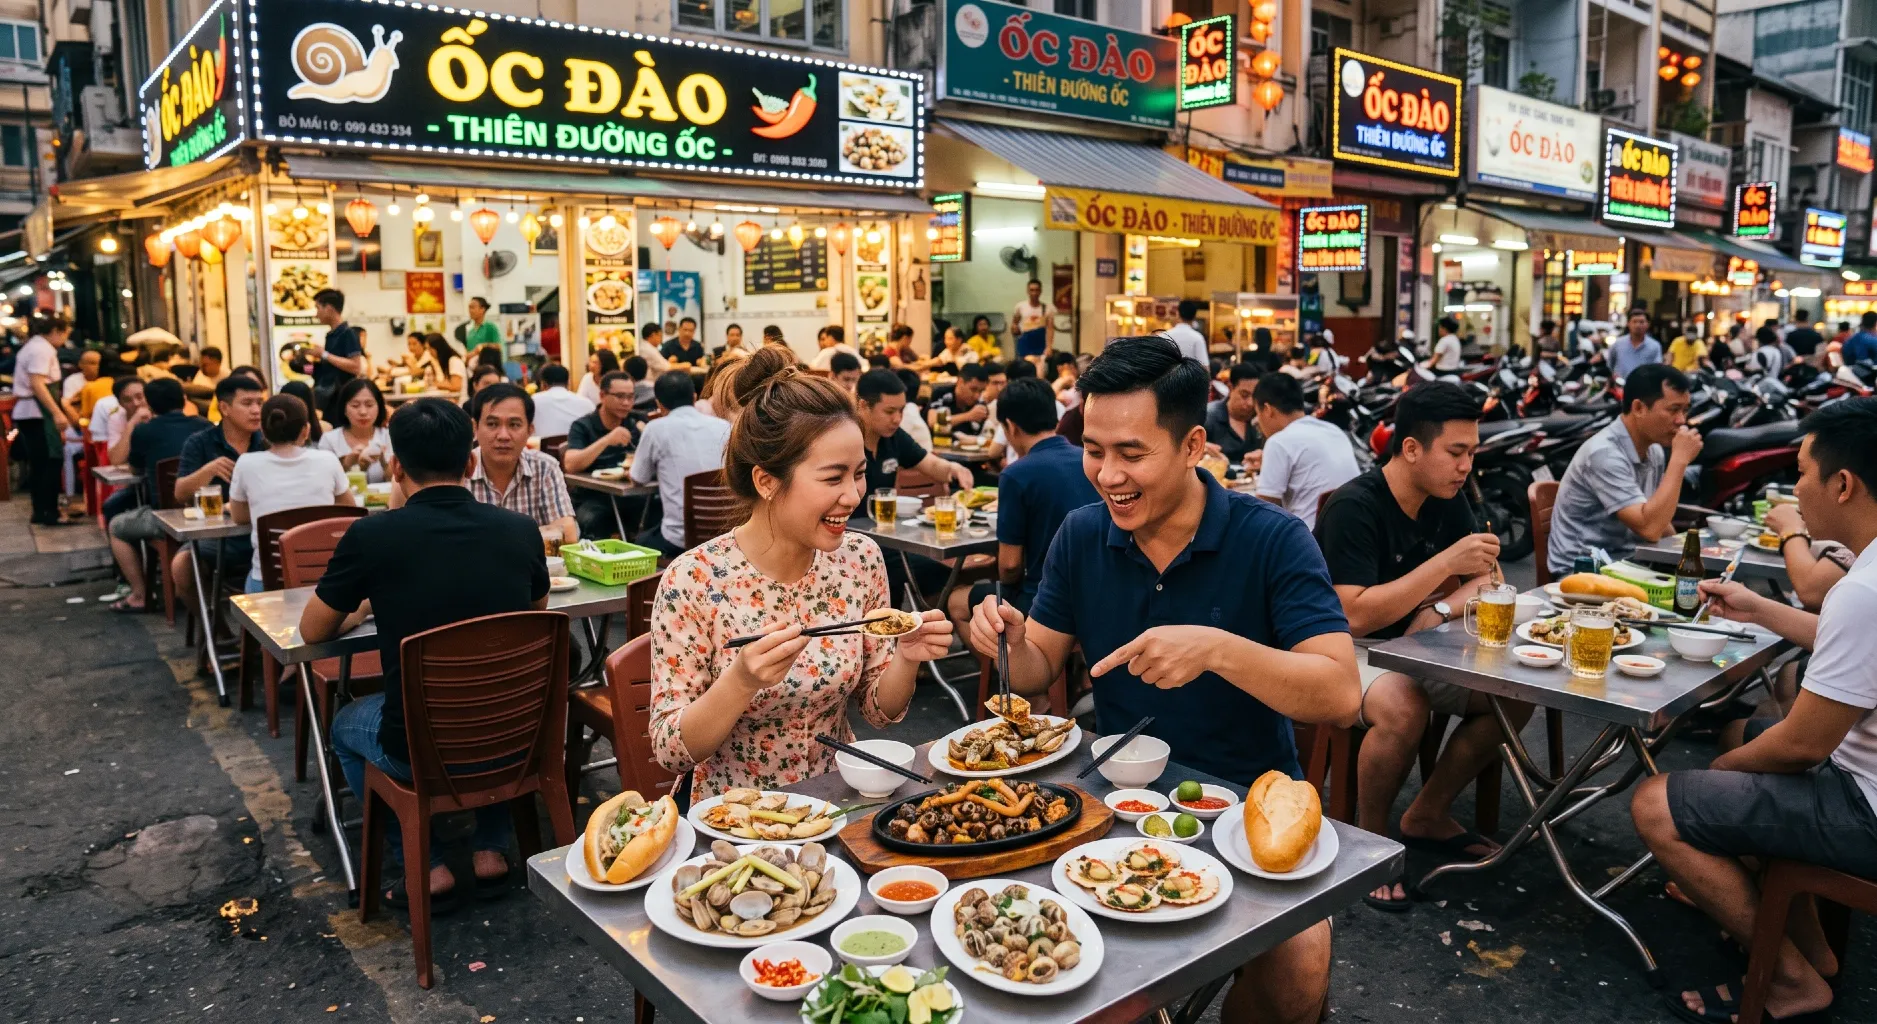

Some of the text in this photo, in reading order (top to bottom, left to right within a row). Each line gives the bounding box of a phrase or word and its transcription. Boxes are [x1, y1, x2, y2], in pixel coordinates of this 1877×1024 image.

[999, 12, 1155, 83] ỐC ĐÀO
[1188, 23, 1225, 58] ỐC
[427, 19, 727, 125] ỐC ĐÀO
[1012, 70, 1057, 95] THIÊN
[1060, 78, 1107, 104] ĐƯỜNG
[1110, 81, 1130, 107] ỐC
[1363, 71, 1399, 123] ỐC
[1400, 87, 1450, 133] ĐÀO
[447, 113, 548, 147] THIÊN
[555, 121, 668, 156] ĐƯỜNG
[675, 127, 716, 160] ỐC
[1509, 120, 1534, 155] ỐC
[1085, 194, 1117, 228] ỐC
[1122, 203, 1168, 232] ĐÀO
[1218, 211, 1257, 239] ĐƯỜNG
[1259, 212, 1276, 240] ỐC
